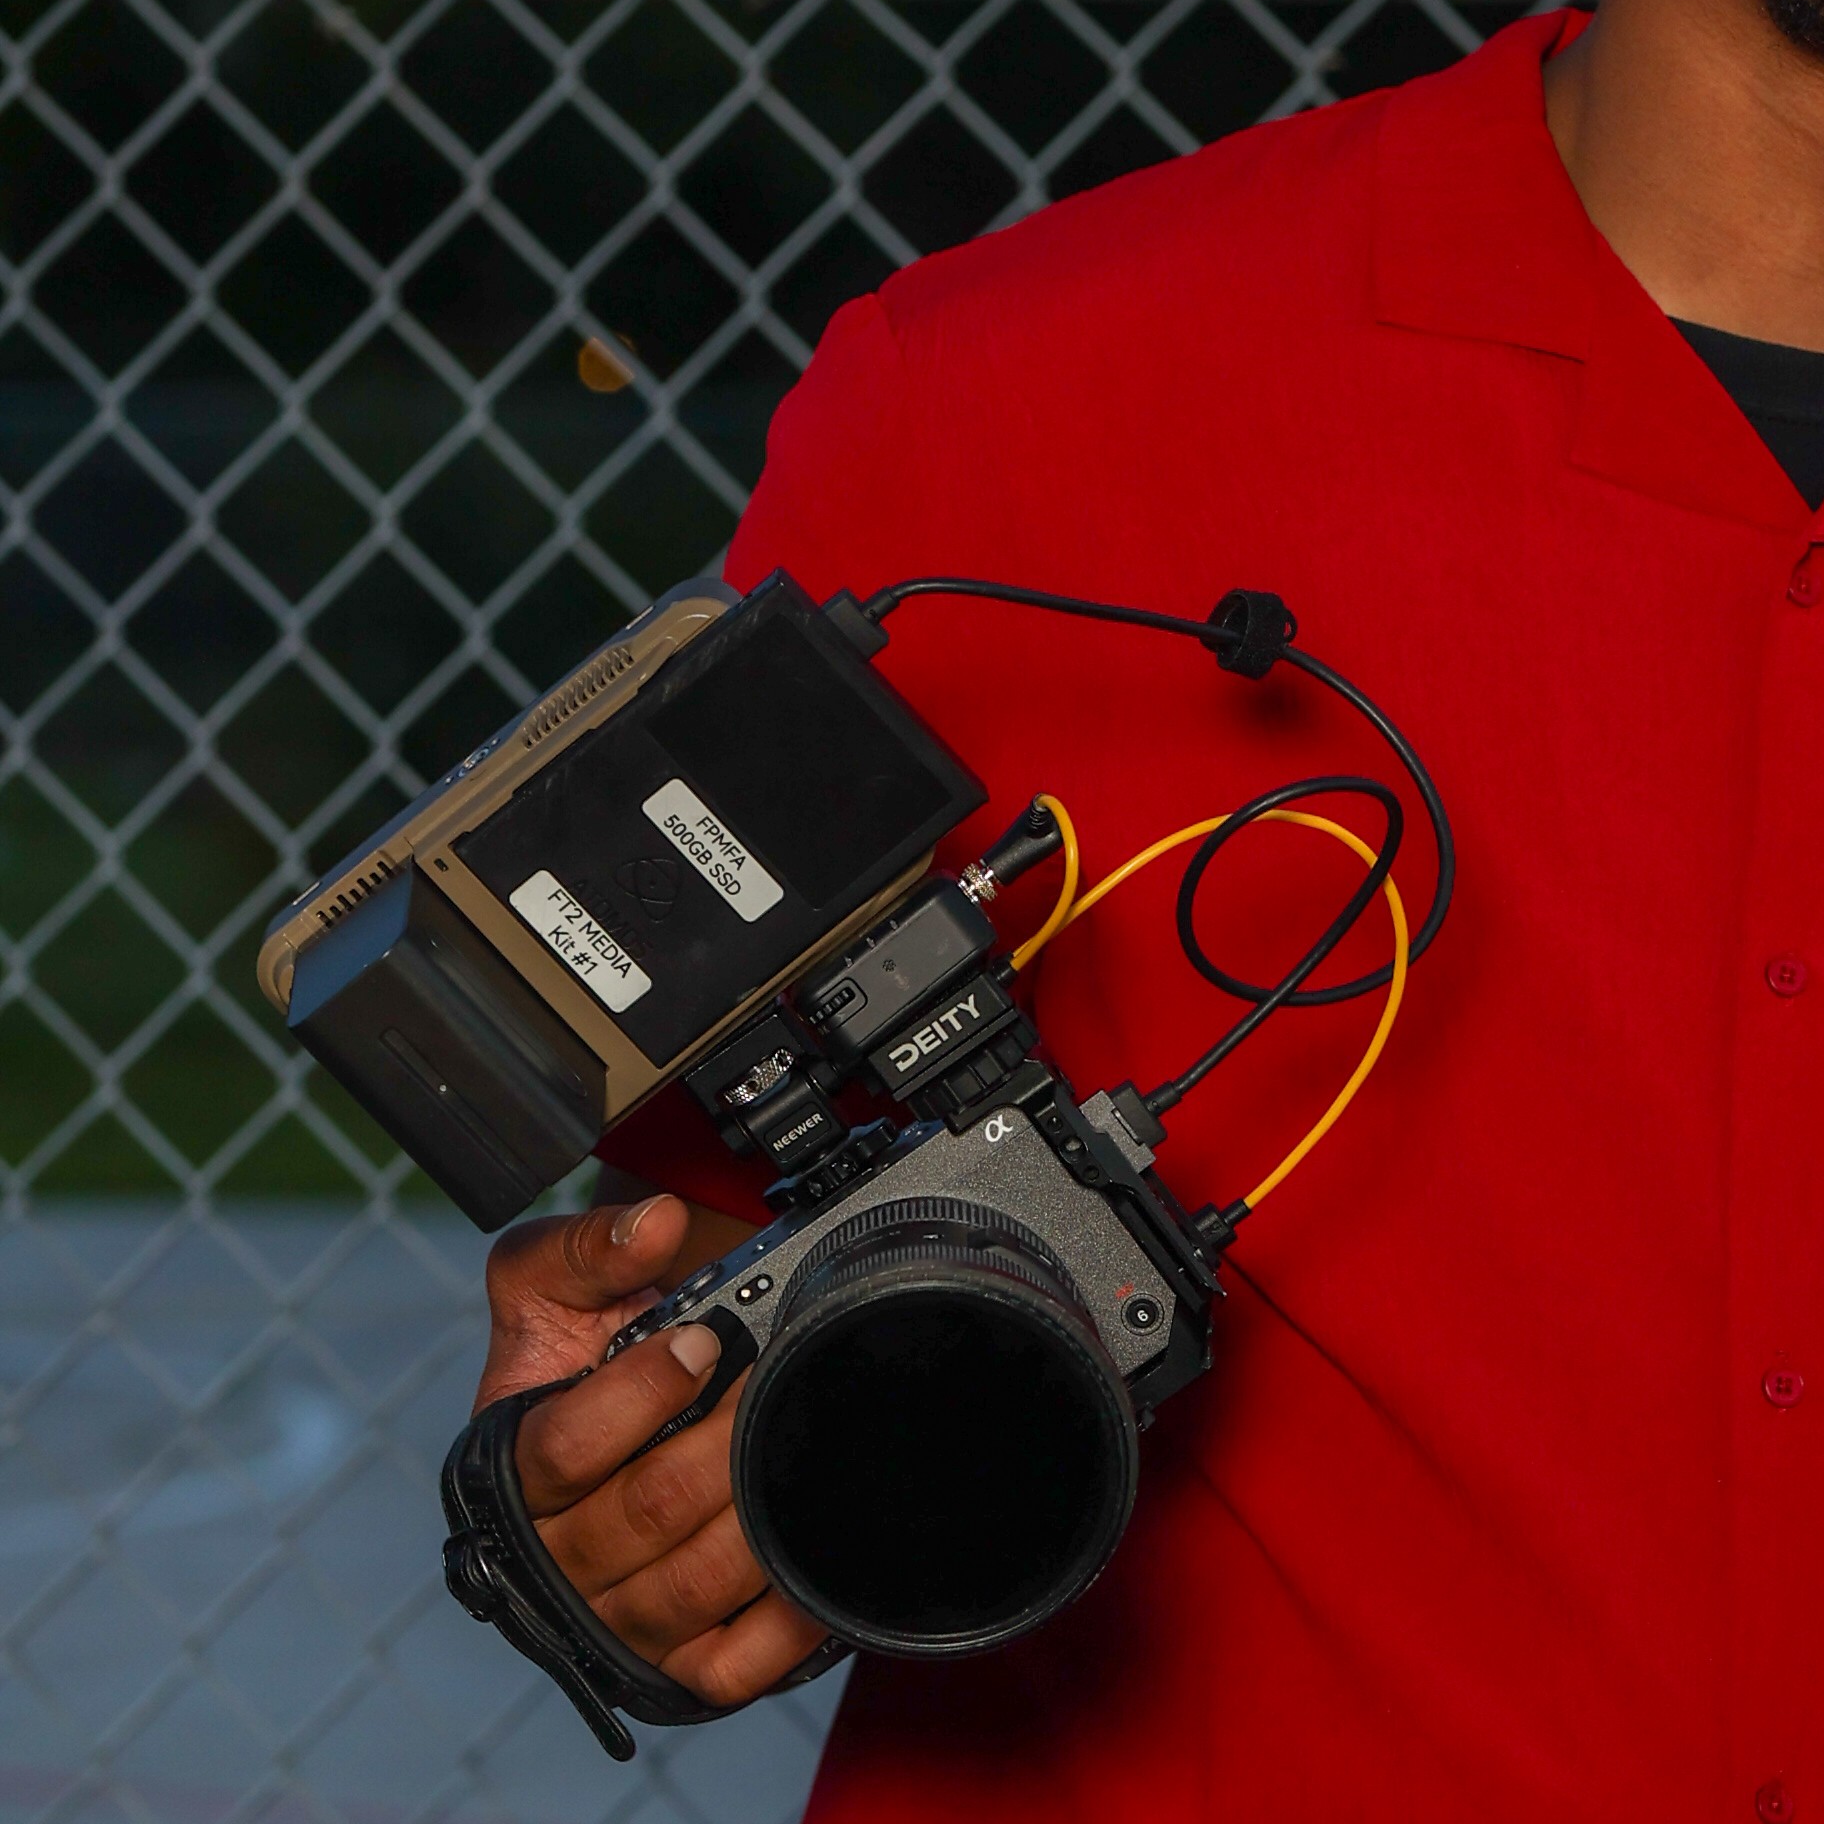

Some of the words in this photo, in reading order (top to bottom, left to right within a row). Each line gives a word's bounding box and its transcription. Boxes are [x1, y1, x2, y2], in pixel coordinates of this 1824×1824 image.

[662, 813, 713, 866] 500GB
[708, 862, 742, 897] SSD
[695, 815, 748, 872] FPMFA
[547, 888, 585, 925] FT2
[578, 920, 634, 980] MEDIA
[547, 925, 576, 955] Kit
[570, 951, 599, 976] #1
[888, 993, 981, 1073] DEITY
[772, 1112, 825, 1153] NEEWER
[1136, 1309, 1149, 1323] 6
